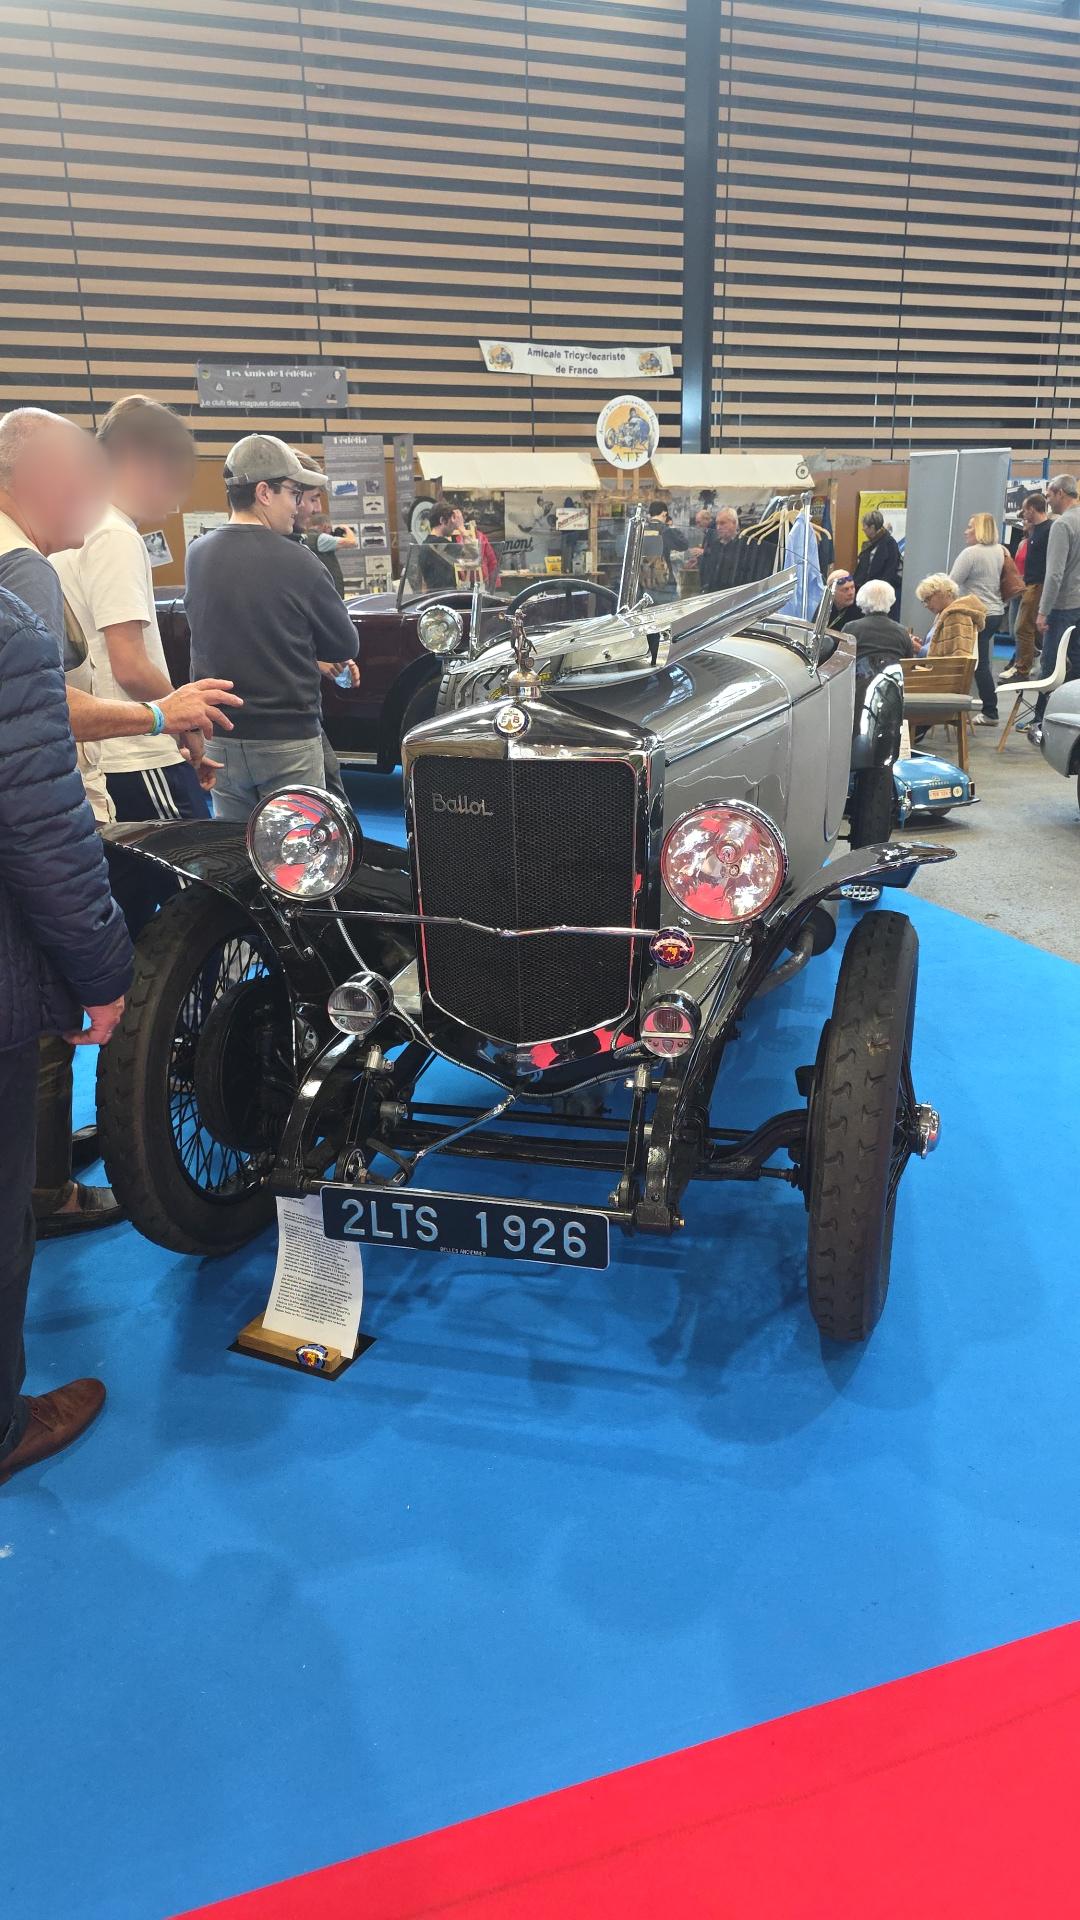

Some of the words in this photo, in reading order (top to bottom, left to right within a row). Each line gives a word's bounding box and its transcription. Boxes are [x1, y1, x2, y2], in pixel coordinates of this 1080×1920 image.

[527, 347, 561, 359] Amicale
[564, 349, 626, 361] Tricyclecariste
[555, 364, 566, 374] de
[568, 365, 599, 375] France
[211, 399, 226, 407] club
[341, 1198, 439, 1243] 2LTS
[475, 1211, 587, 1259] 1926
